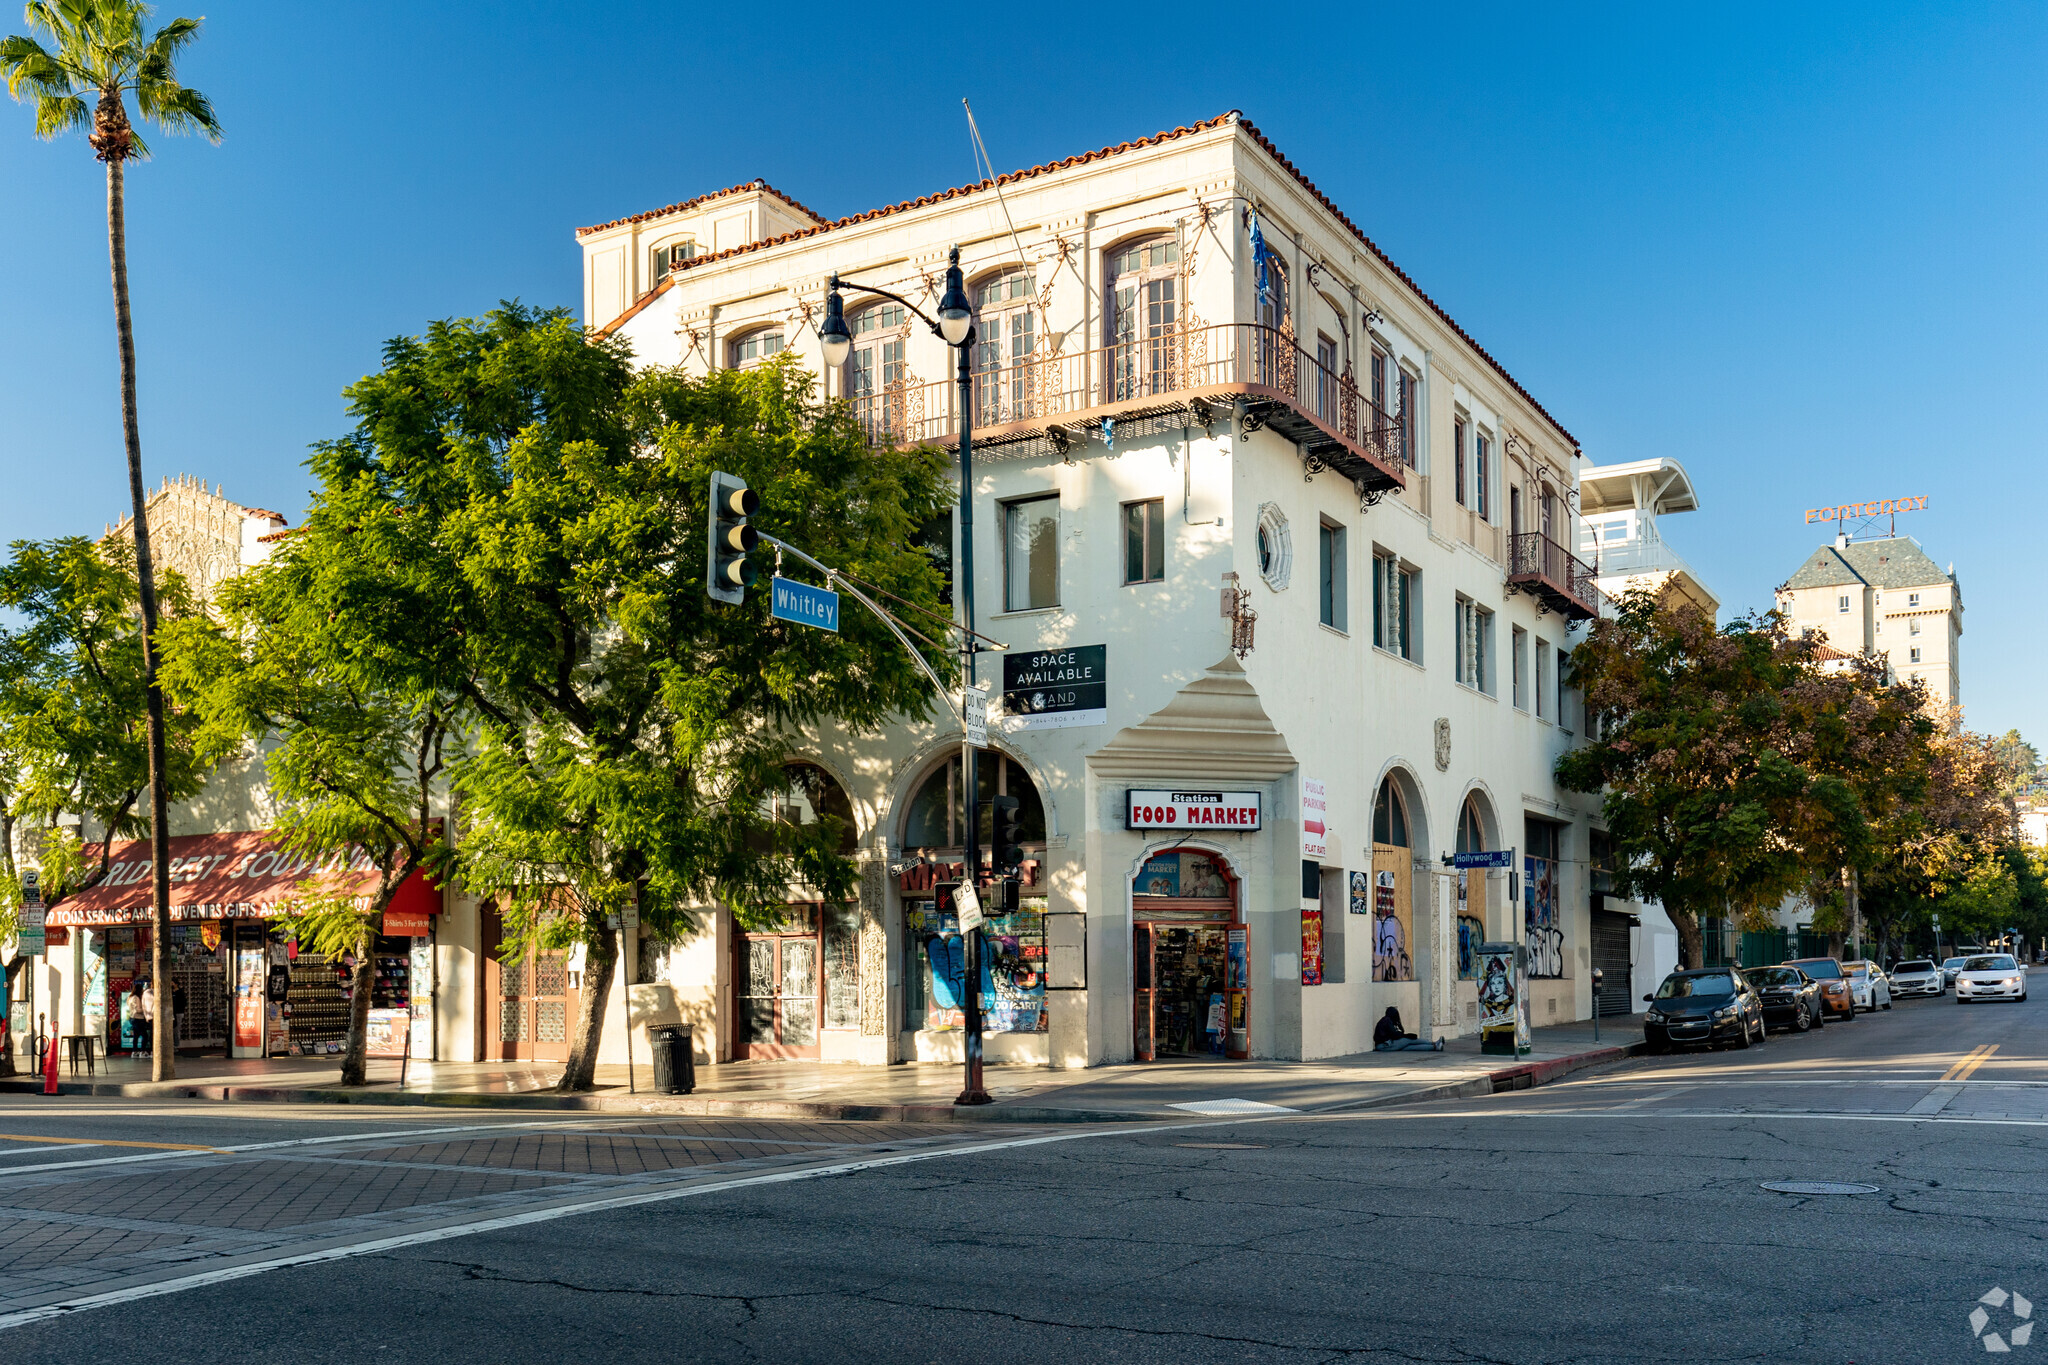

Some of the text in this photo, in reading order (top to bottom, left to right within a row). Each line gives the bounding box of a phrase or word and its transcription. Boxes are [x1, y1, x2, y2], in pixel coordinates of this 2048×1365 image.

[1805, 494, 1929, 525] FONTENOY
[777, 587, 834, 625] Whitley
[1032, 652, 1076, 668] SPACE
[1016, 666, 1092, 685] AVAILABLE
[967, 694, 986, 710] DO NOT
[1047, 691, 1077, 705] AND
[967, 712, 987, 729] BLOCK
[1305, 781, 1325, 796] PUBLIC
[1172, 793, 1218, 803] Station
[1303, 797, 1327, 812] PARKING
[1133, 806, 1258, 825] FOOD MARKET
[1304, 843, 1327, 855] FLAT RATE
[1456, 852, 1510, 863] Hollywood Bl
[168, 855, 228, 882] BEST
[890, 856, 922, 877] Station
[57, 910, 84, 924] TOUR
[86, 907, 128, 923] SERVICE
[131, 906, 154, 921] AND
[168, 903, 223, 920] OUVENIRS
[226, 902, 257, 917] GIFTS
[259, 900, 287, 917] AND
[384, 919, 403, 927] T-Shirts
[408, 919, 417, 927] For
[417, 919, 430, 927] $9.99
[909, 911, 925, 929] 19
[1025, 946, 1037, 957] 20
[1027, 972, 1037, 982] 13
[240, 1010, 245, 1018] 3
[239, 1020, 256, 1030] $9.99
